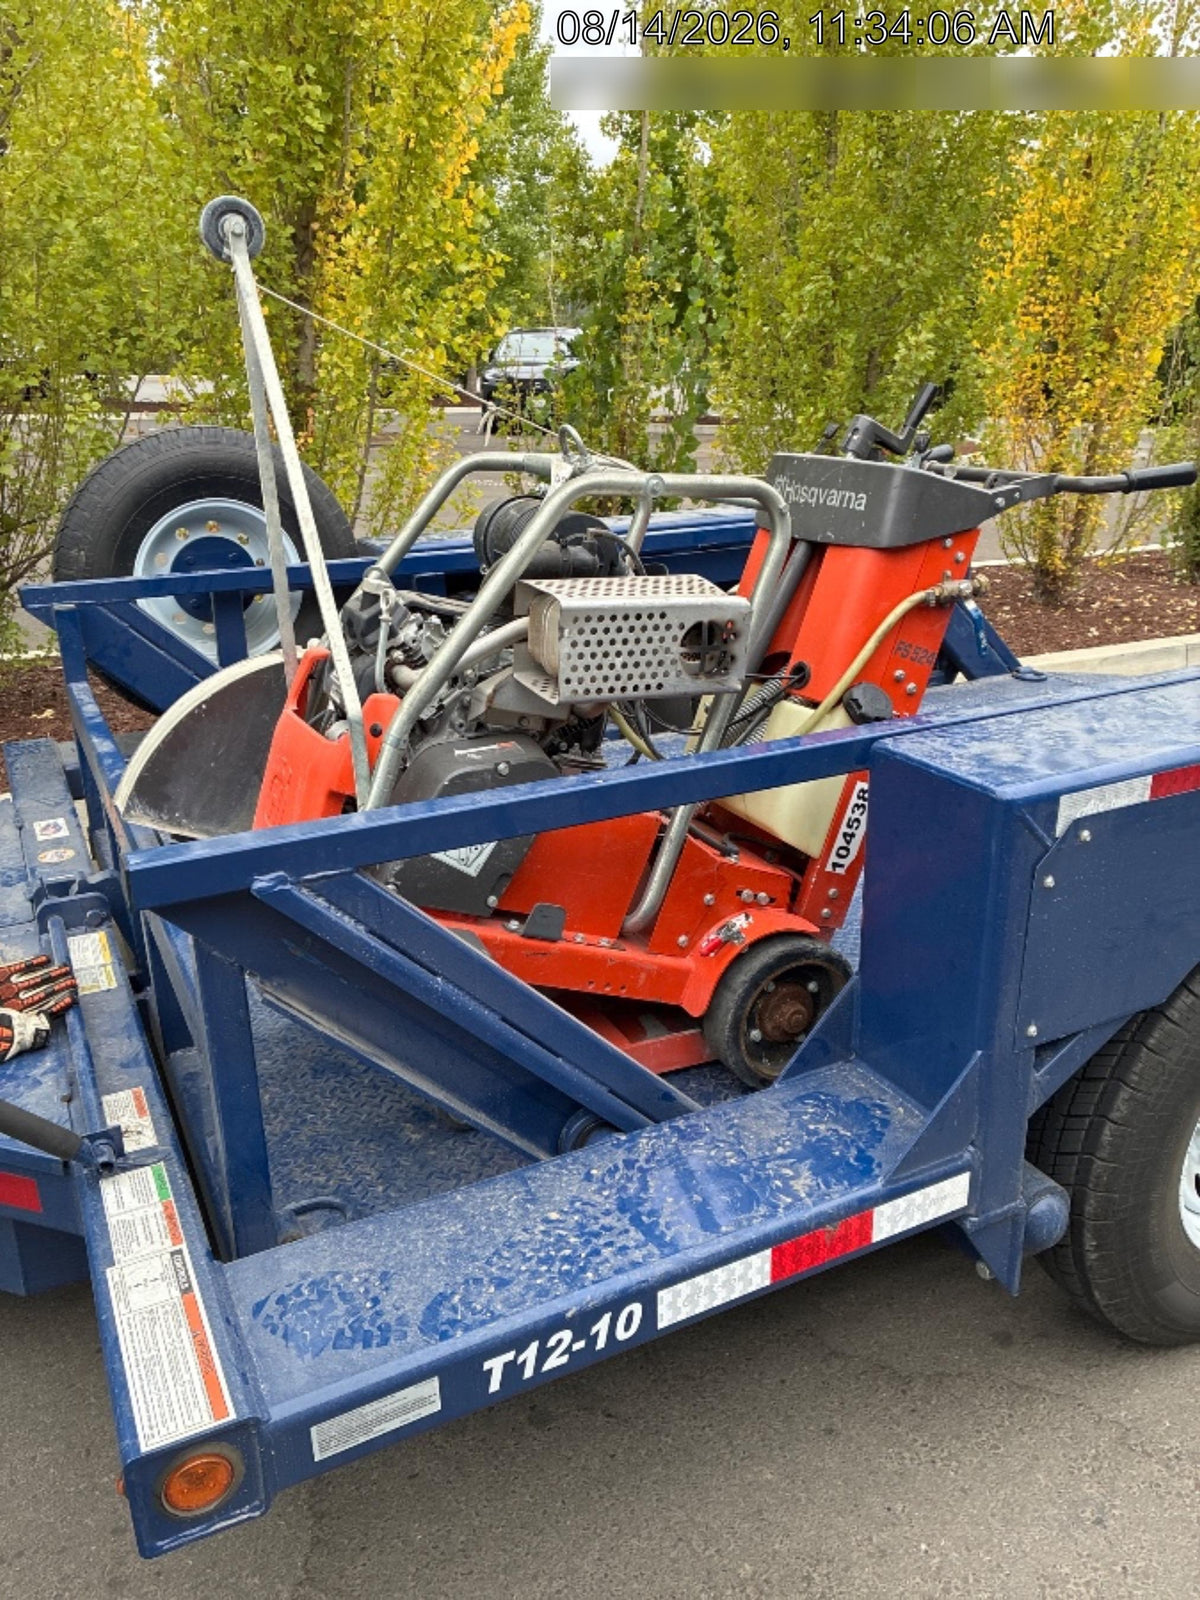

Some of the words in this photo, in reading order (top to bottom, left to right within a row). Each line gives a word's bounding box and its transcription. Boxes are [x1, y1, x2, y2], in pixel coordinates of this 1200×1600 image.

[782, 480, 867, 511] Husqvarna
[894, 640, 912, 658] FS
[831, 787, 868, 872] 104538
[483, 1302, 643, 1394] T12-10
